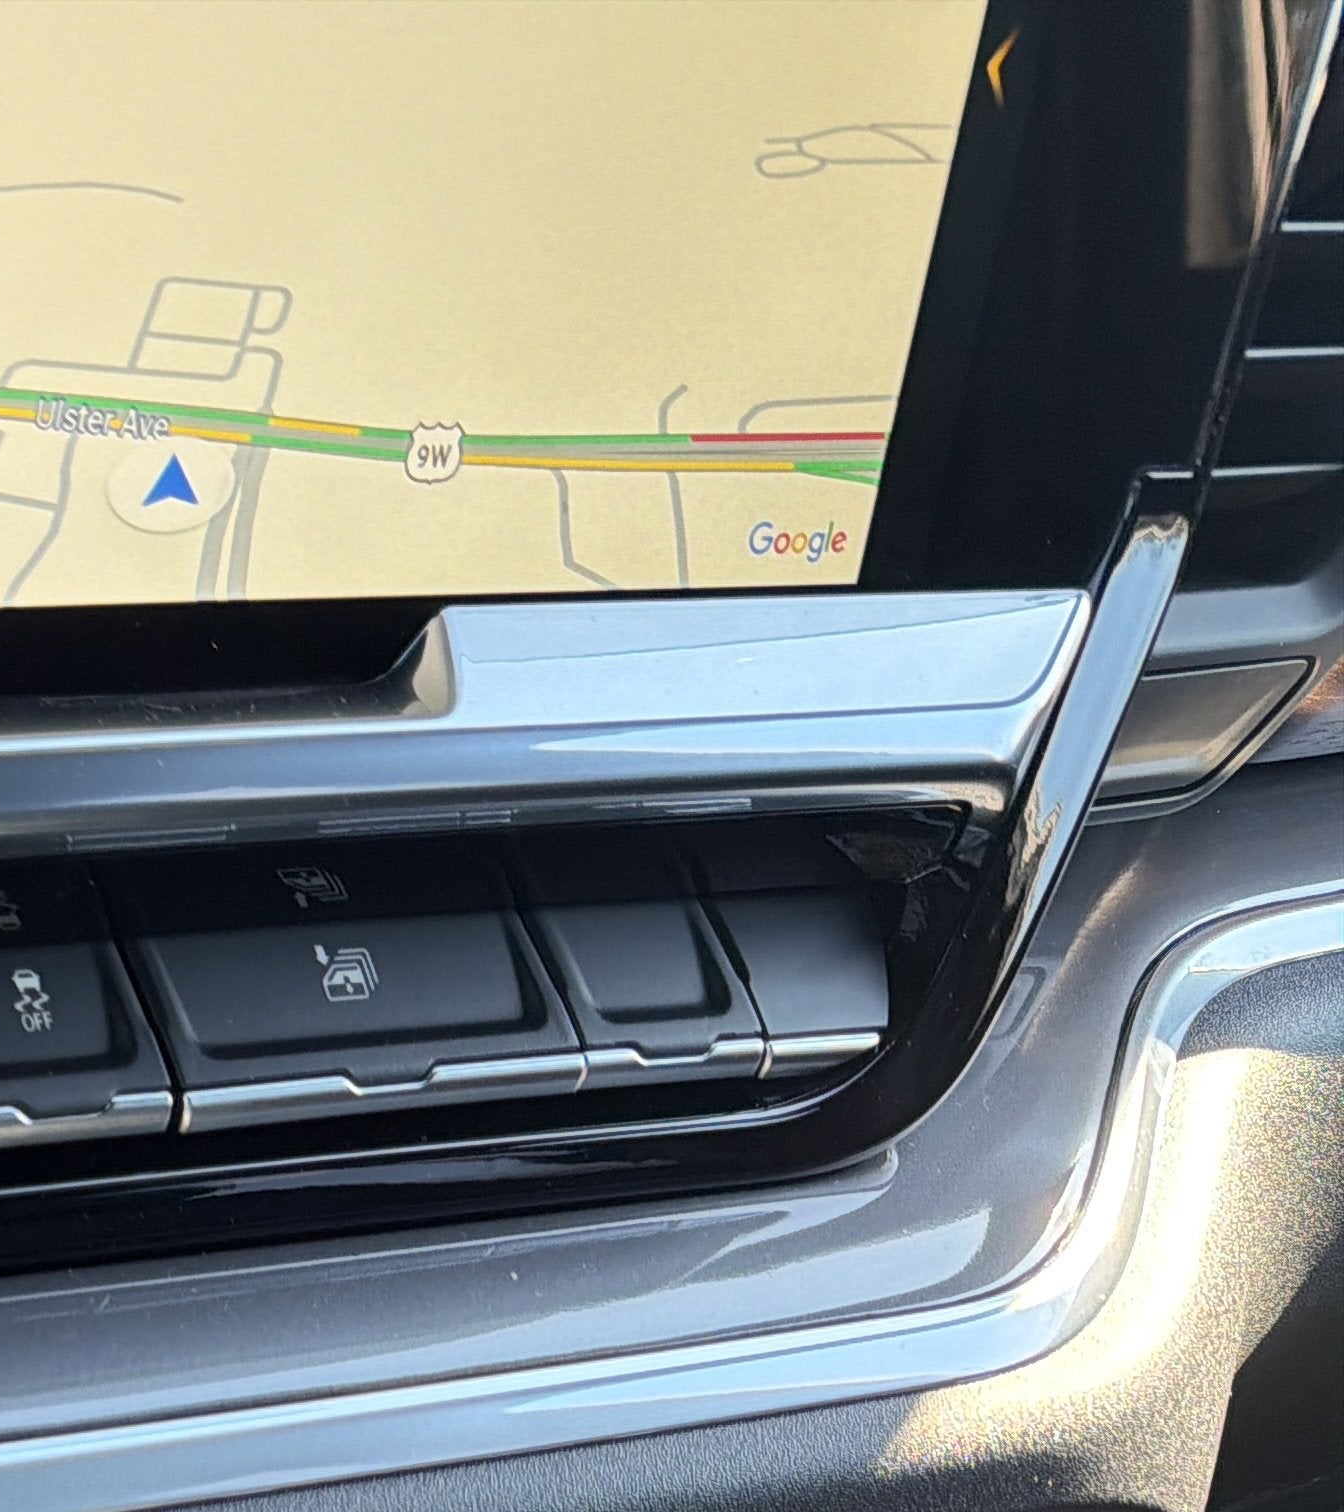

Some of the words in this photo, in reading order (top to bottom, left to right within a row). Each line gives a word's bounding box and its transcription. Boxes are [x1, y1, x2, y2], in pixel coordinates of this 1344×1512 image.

[34, 395, 116, 436] Ulster
[117, 406, 171, 441] Ave
[417, 444, 452, 468] 9W
[749, 520, 847, 563] Google
[21, 1010, 53, 1032] OFF
